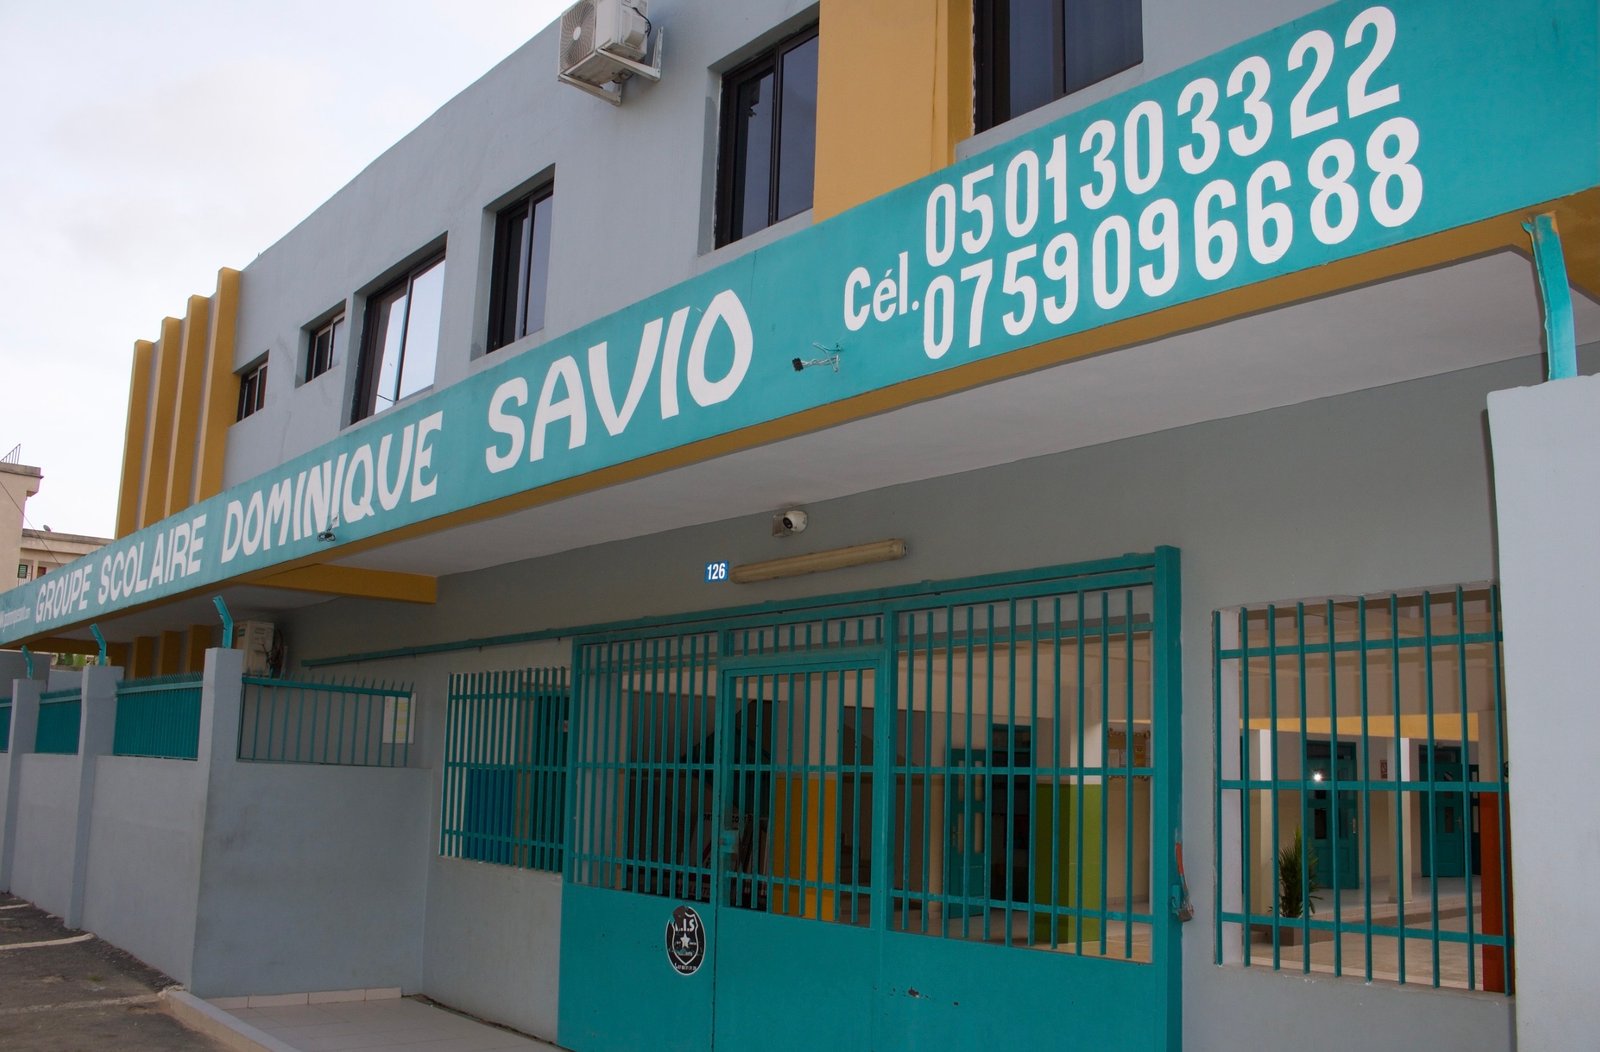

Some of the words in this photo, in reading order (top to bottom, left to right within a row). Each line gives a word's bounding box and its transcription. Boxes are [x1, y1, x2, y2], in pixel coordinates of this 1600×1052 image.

[843, 251, 919, 331] Cél.
[35, 564, 93, 624] GROUPE
[98, 514, 207, 604] SCOLAIRE
[221, 410, 443, 563] DOMINIQUE
[485, 289, 753, 474] SAVIO
[707, 562, 726, 580] 126
